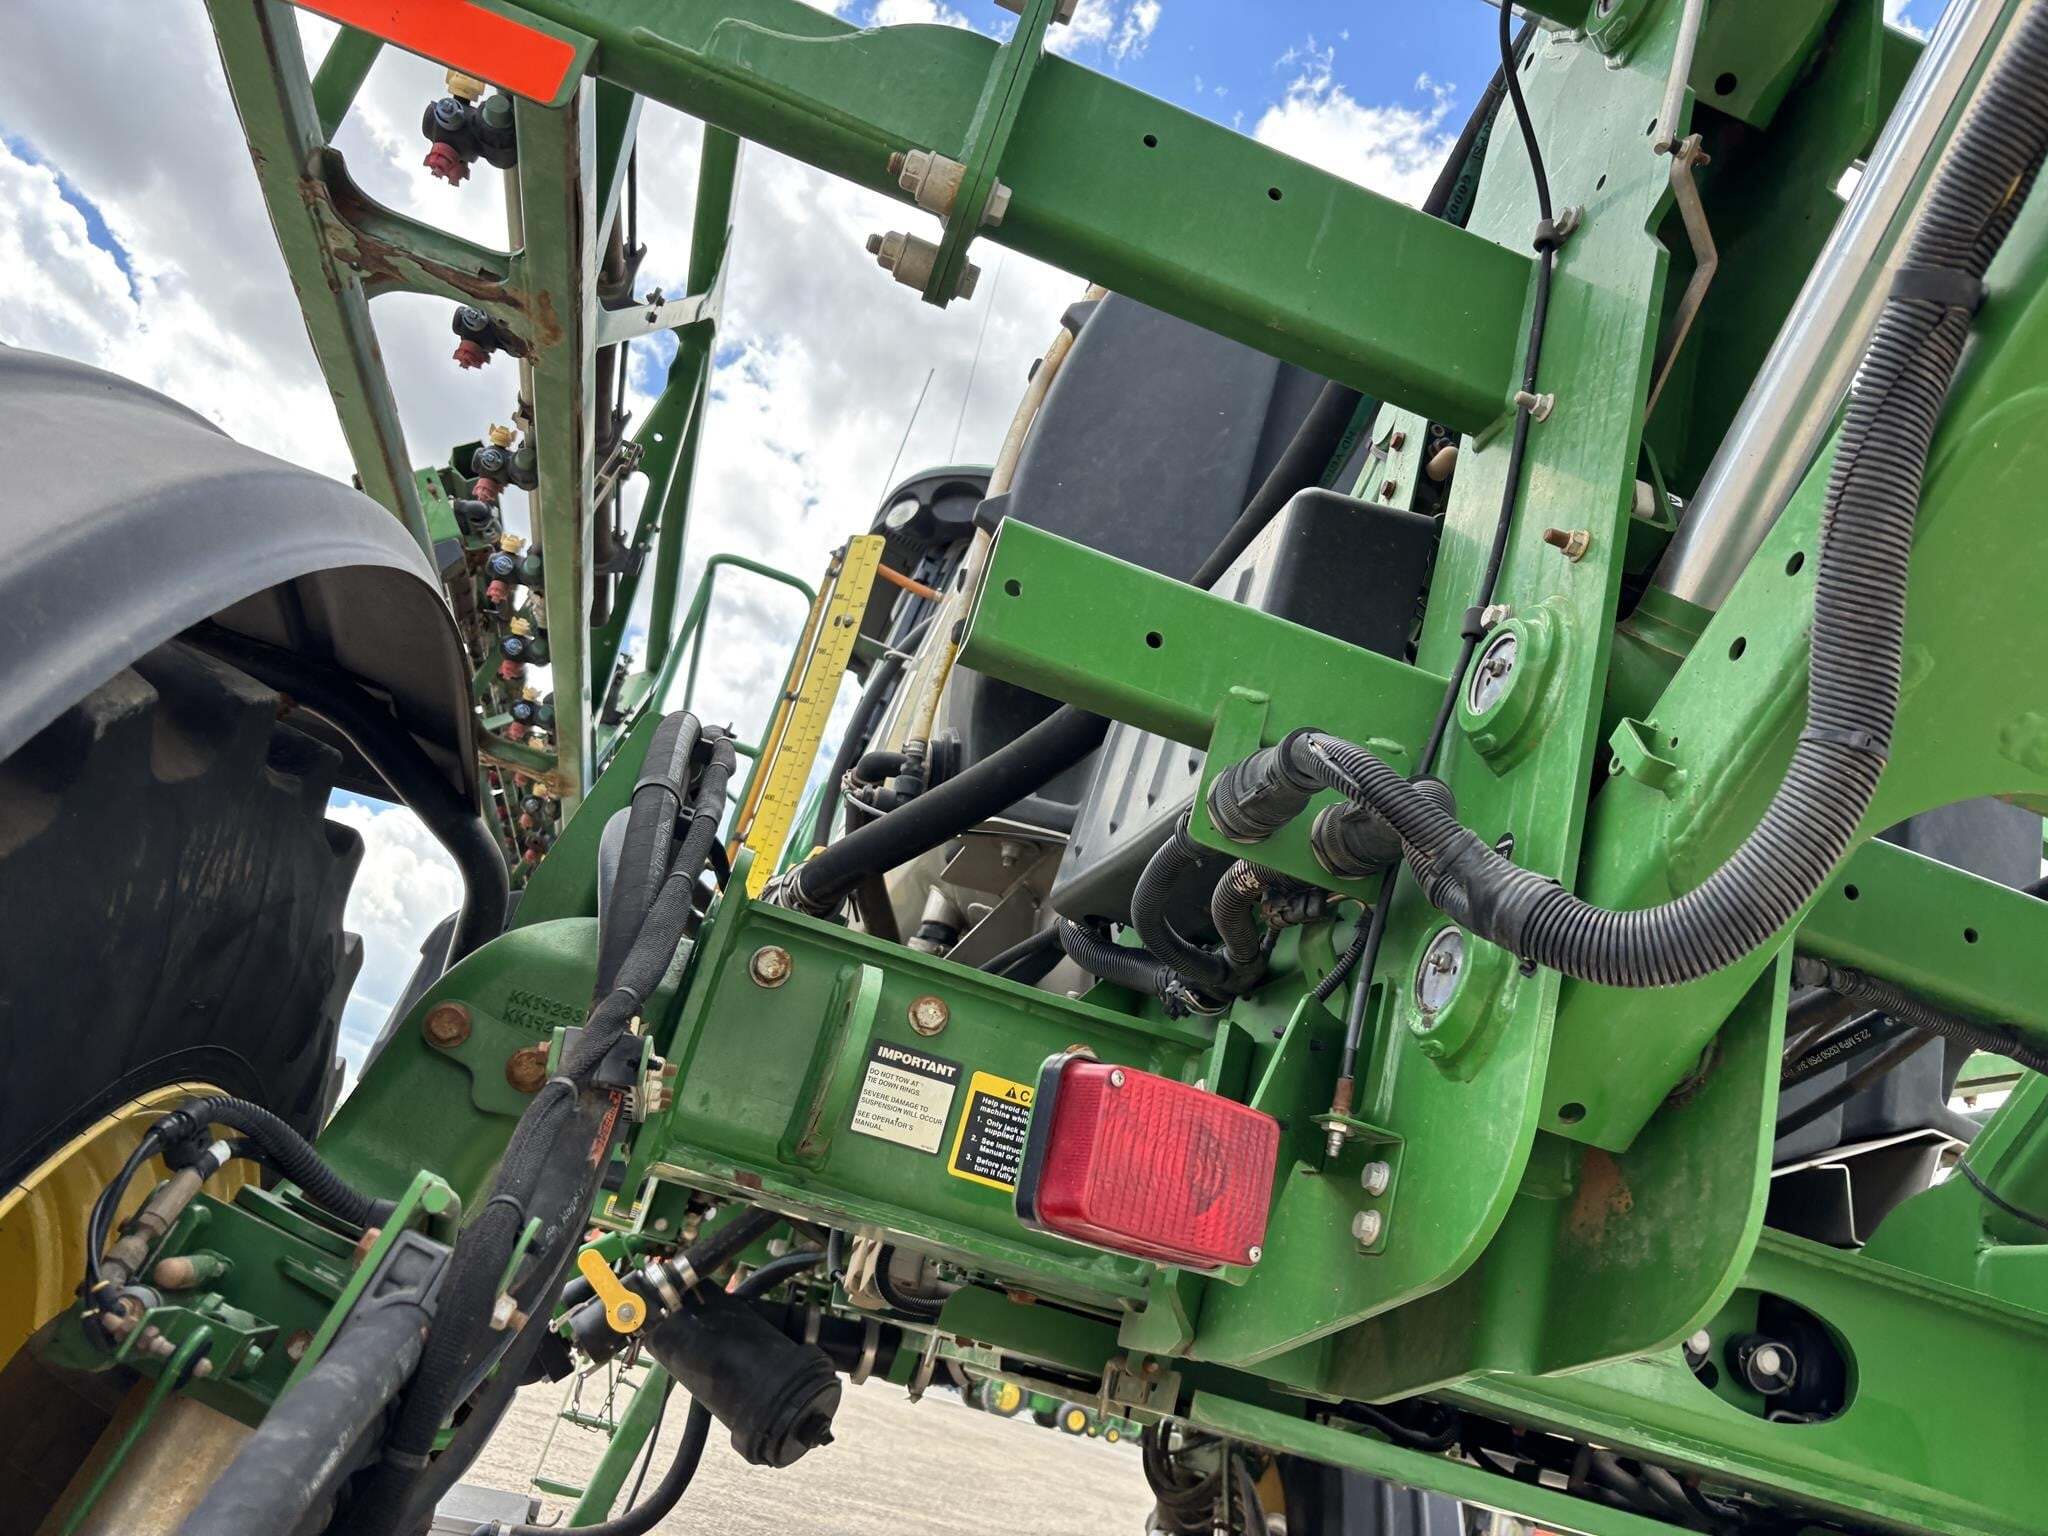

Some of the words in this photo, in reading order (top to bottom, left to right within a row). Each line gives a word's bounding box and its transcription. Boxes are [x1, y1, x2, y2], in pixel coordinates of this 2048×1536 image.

[877, 1046, 956, 1077] IMPORTANT
[868, 1076, 878, 1084] TIE
[878, 1079, 899, 1090] DOWN
[870, 1068, 880, 1076] DO
[880, 1071, 894, 1080] NOT
[895, 1075, 910, 1084] TOW
[861, 1096, 902, 1114] SUSPENSION
[903, 1108, 918, 1119] WILL
[863, 1088, 890, 1102] SEVERE
[890, 1096, 920, 1110] DAMAGE
[920, 1104, 929, 1113] TO
[982, 1096, 998, 1108] Help
[1000, 1104, 1020, 1114] avoid
[857, 1110, 870, 1118] SEE
[872, 1114, 914, 1131] OPERATOR'S
[980, 1106, 1010, 1120] machine
[984, 1127, 1014, 1141] supplied
[986, 1118, 1003, 1130] Only
[1003, 1123, 1018, 1134] jack
[971, 1134, 977, 1142] 2.
[982, 1138, 994, 1147] See
[979, 1145, 1005, 1158] Manual
[966, 1153, 972, 1161] 3.
[976, 1156, 1000, 1169] Before
[974, 1164, 989, 1174] turn
[996, 1172, 1012, 1182] fully
